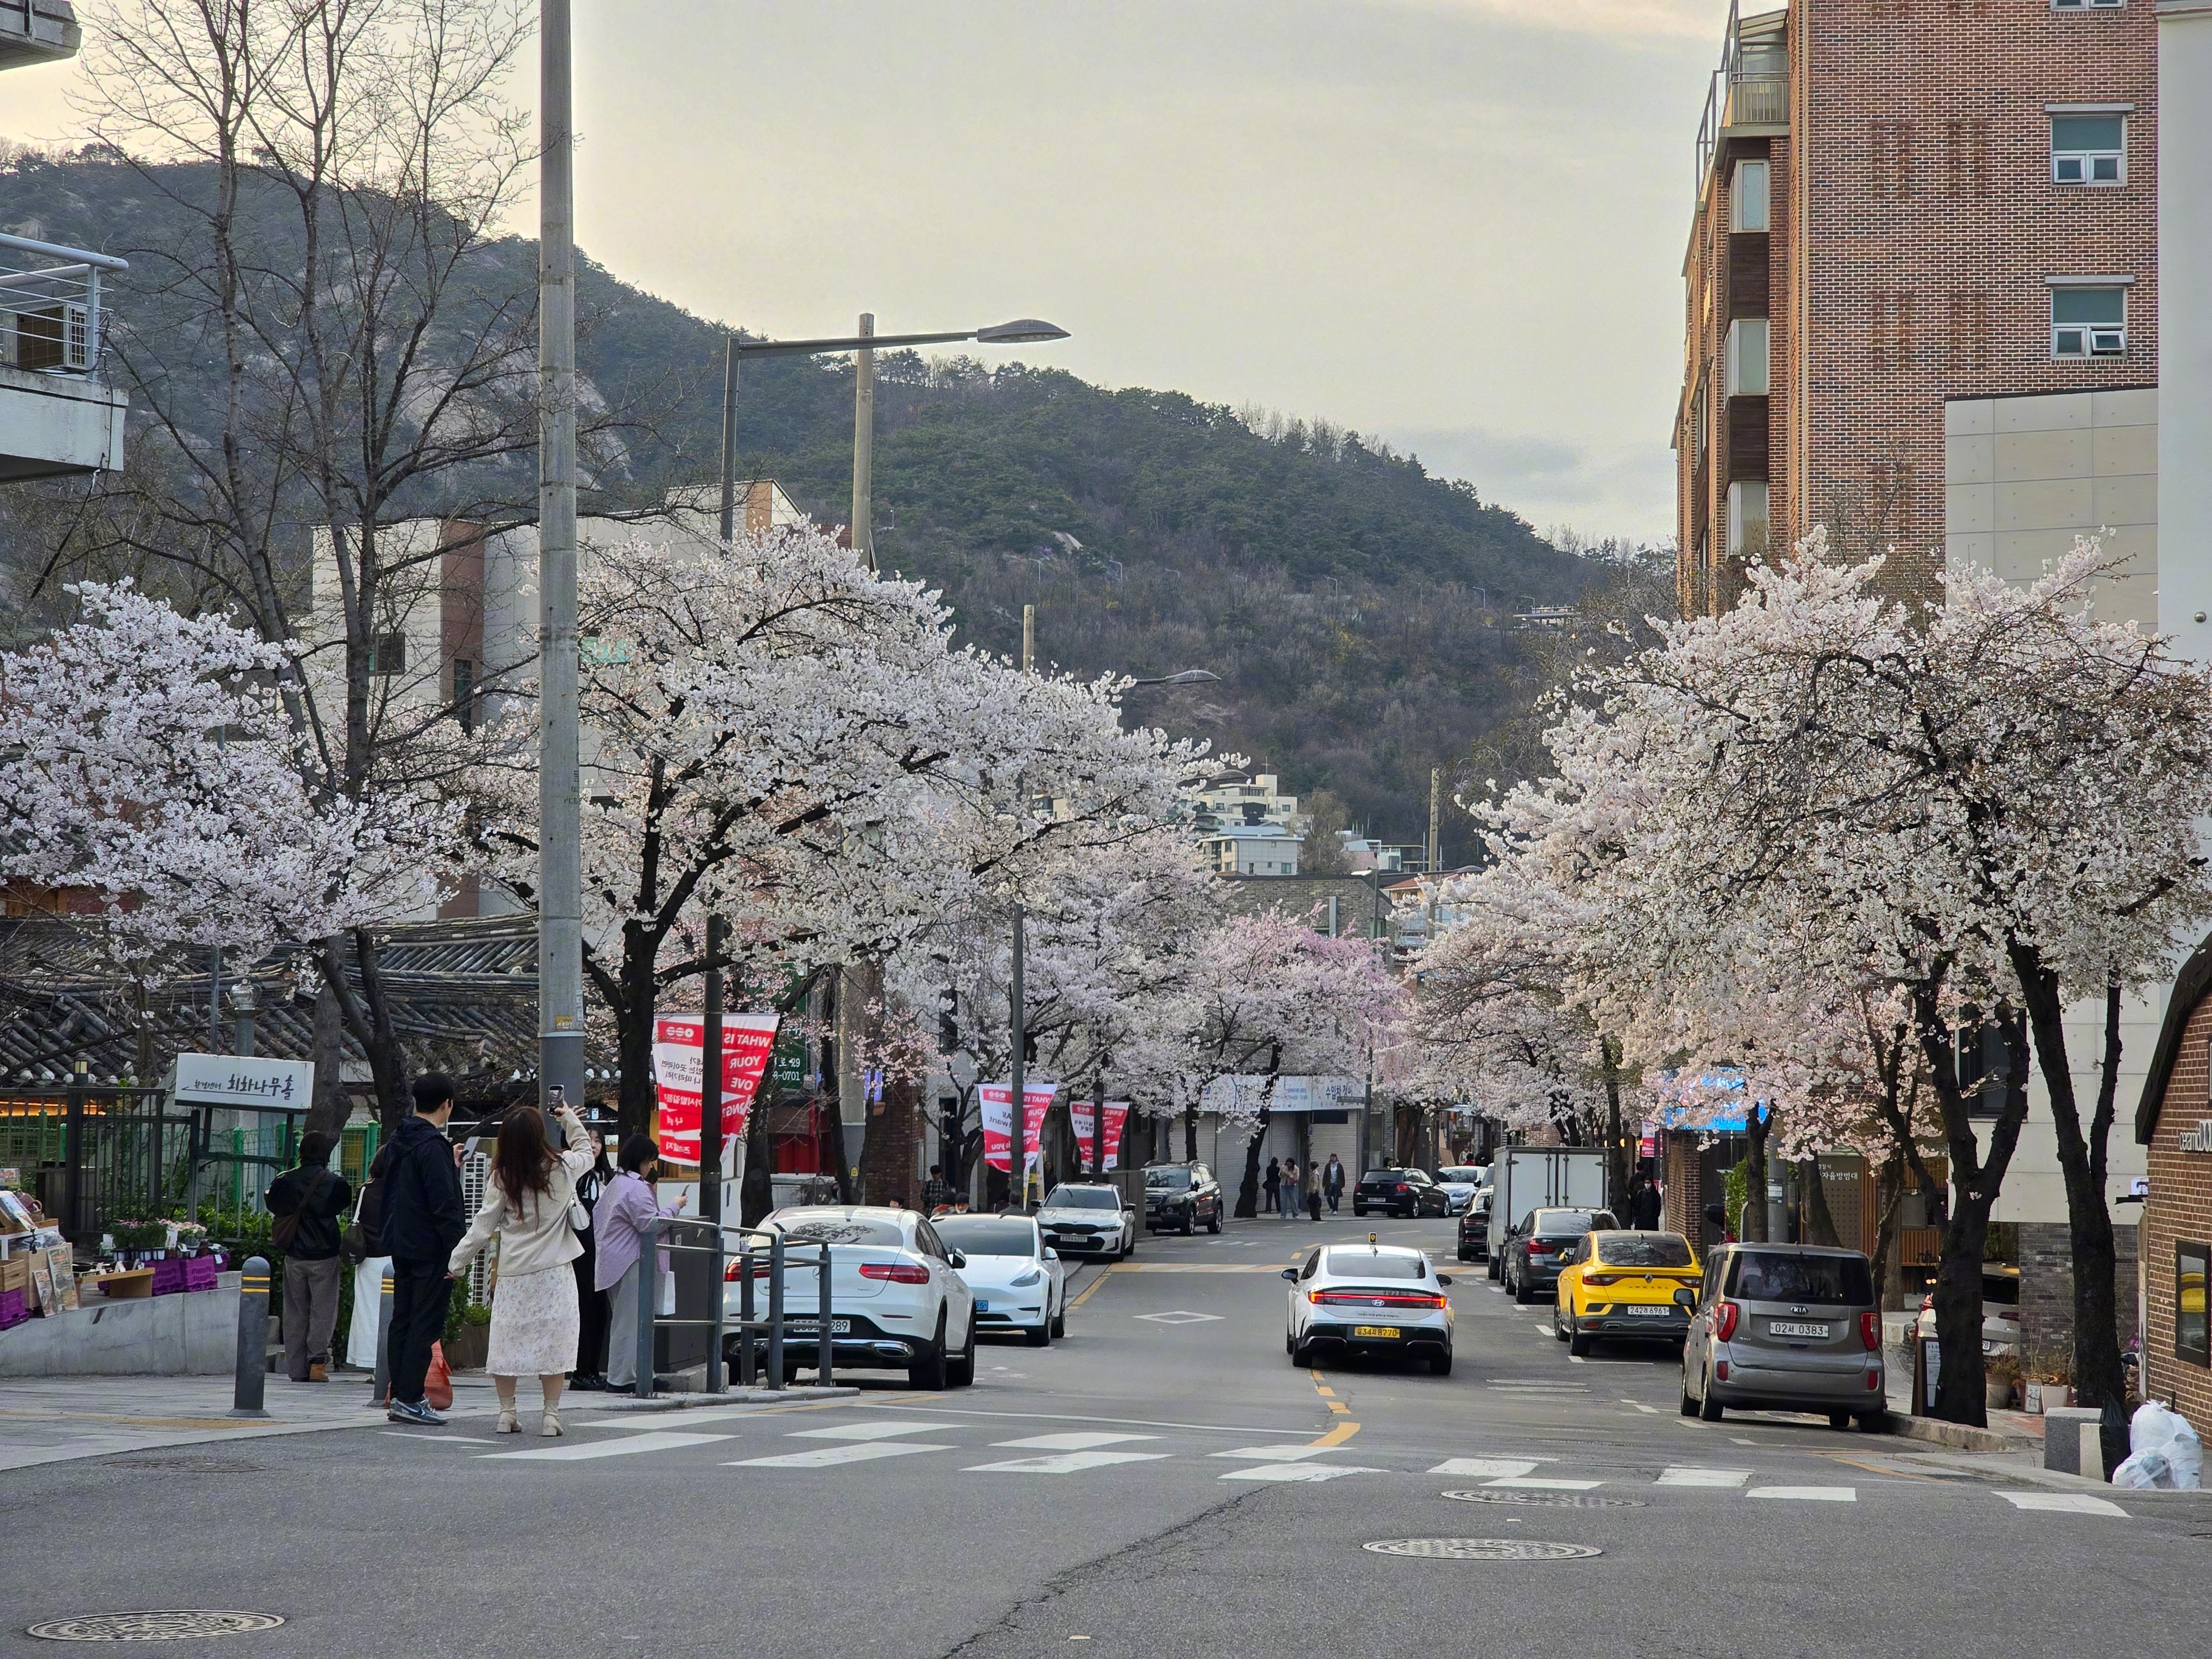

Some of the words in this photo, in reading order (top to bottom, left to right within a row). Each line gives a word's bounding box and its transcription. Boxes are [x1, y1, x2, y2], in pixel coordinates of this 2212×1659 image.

[773, 1071, 800, 1081] 8-0701
[194, 1079, 221, 1090] 환경센터
[227, 1073, 294, 1100] 회화나무홀
[1326, 1084, 1342, 1100] 수입차
[831, 1321, 848, 1331] 289
[1775, 1323, 1794, 1333] 02서
[1798, 1325, 1823, 1335] 0383
